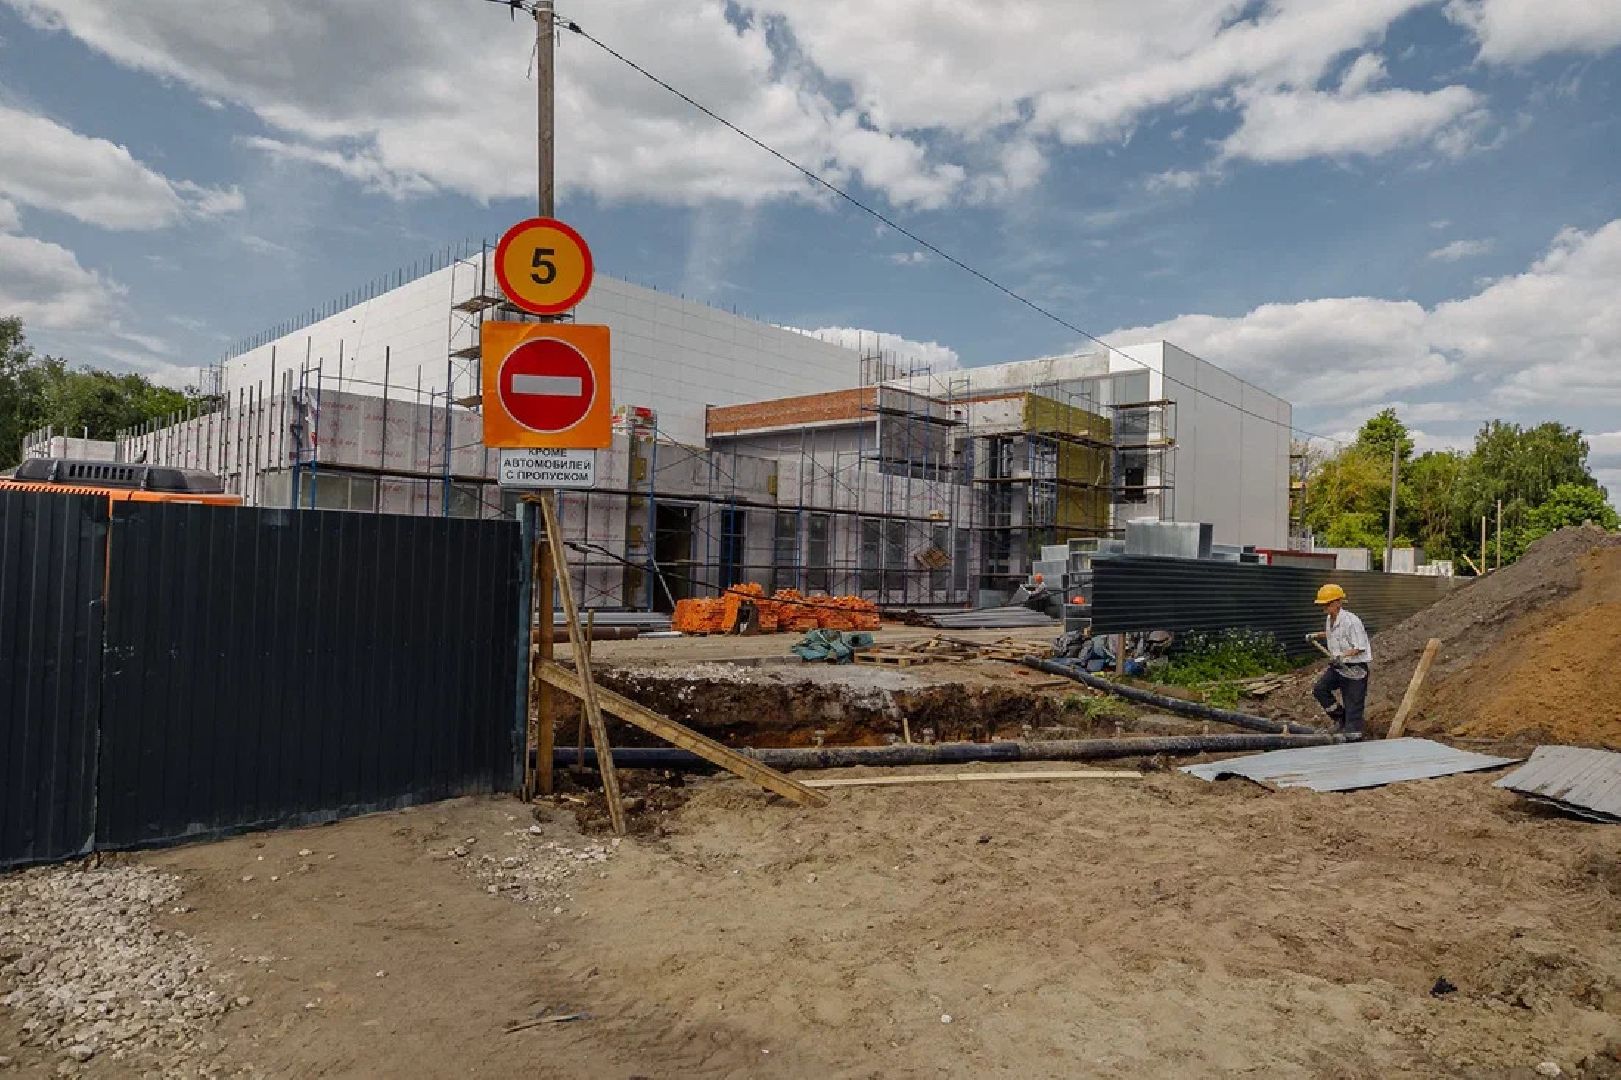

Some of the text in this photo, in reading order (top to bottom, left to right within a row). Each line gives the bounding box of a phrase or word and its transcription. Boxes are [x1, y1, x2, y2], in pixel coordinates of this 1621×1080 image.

[531, 248, 557, 285] 5
[528, 448, 567, 457] КРОМЕ
[503, 458, 592, 470] АВТОМОБИЛЕЙ
[506, 470, 514, 480] С
[517, 471, 589, 481] ПРОПУСКОМ
